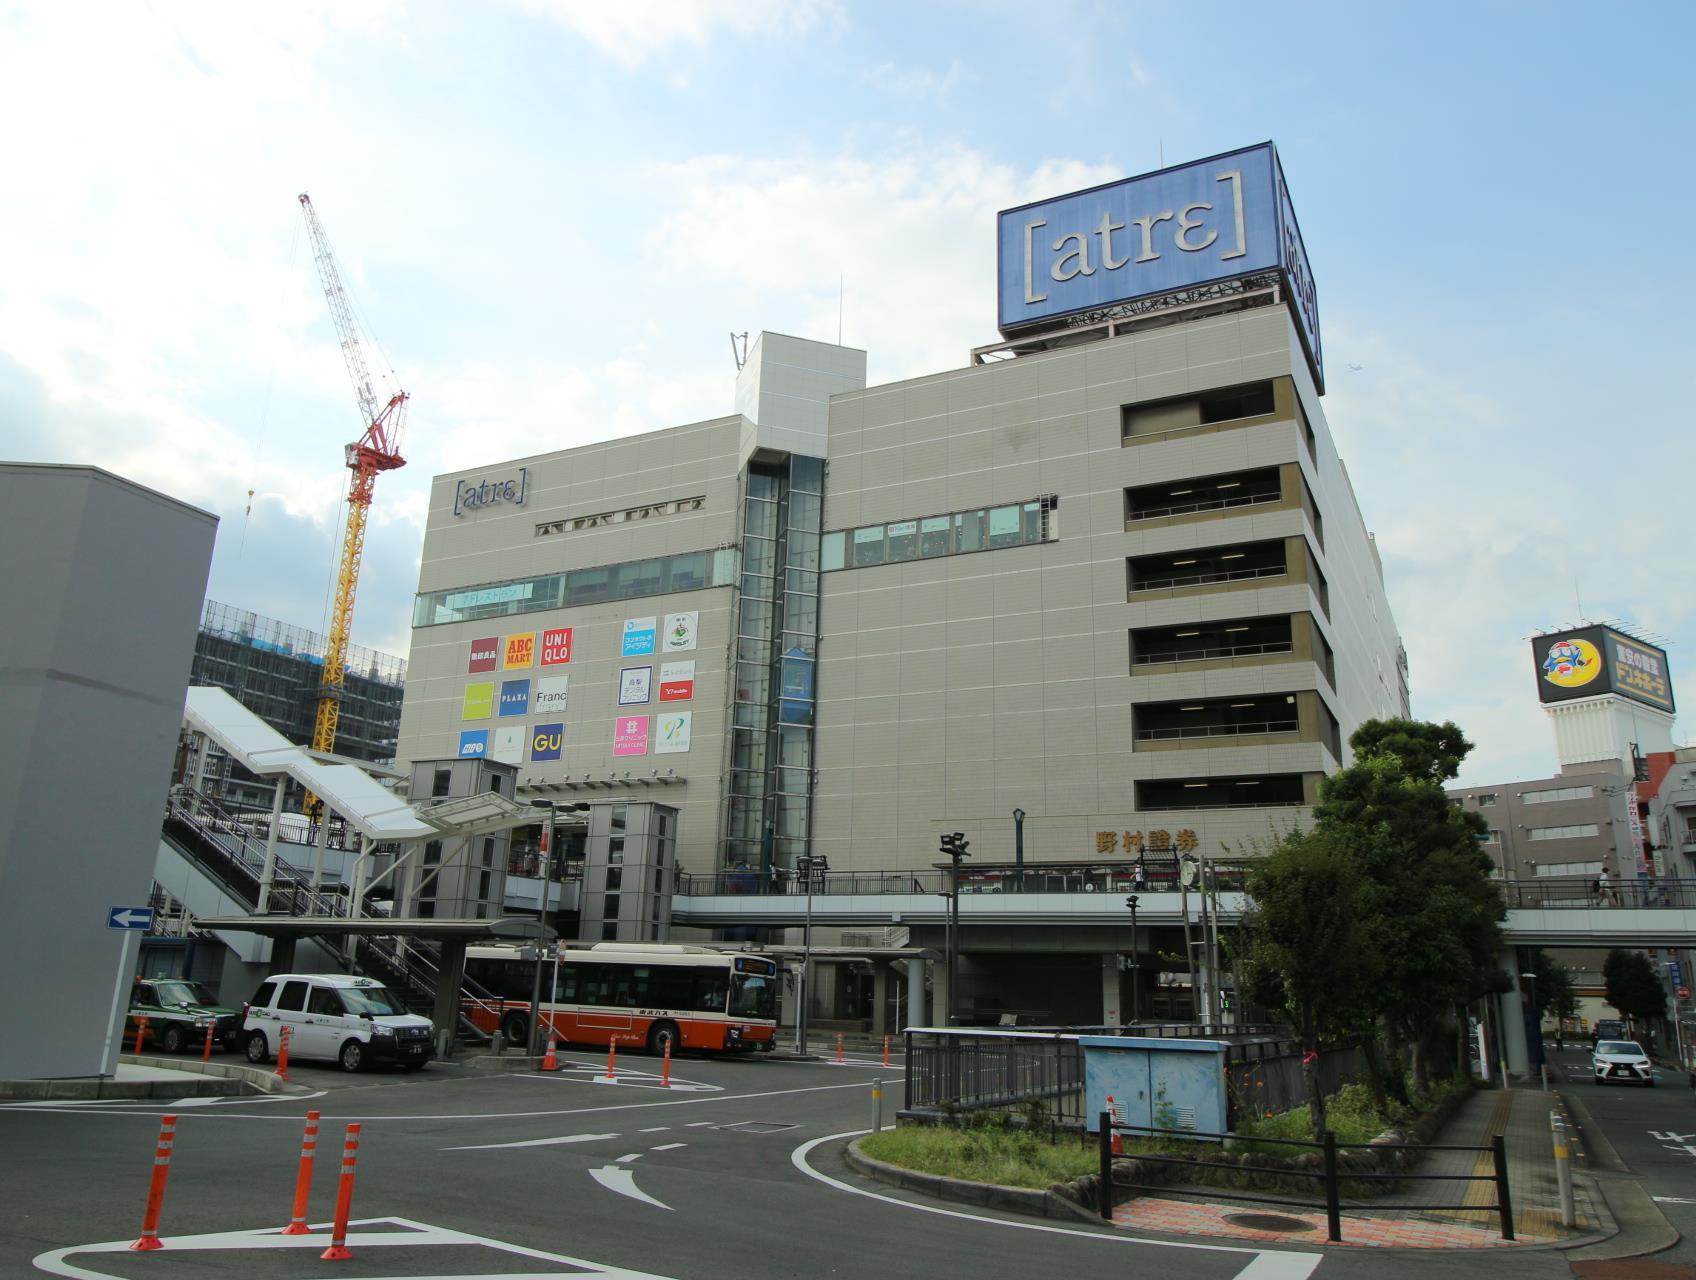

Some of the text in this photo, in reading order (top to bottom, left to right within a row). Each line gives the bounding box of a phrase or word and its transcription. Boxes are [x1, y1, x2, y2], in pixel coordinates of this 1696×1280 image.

[508, 638, 533, 654] ABC
[546, 633, 568, 646] UNI
[506, 653, 532, 664] MART
[545, 647, 568, 662] QLO
[502, 693, 527, 703] PLAZA
[536, 691, 567, 703] Franc
[534, 734, 561, 752] GU
